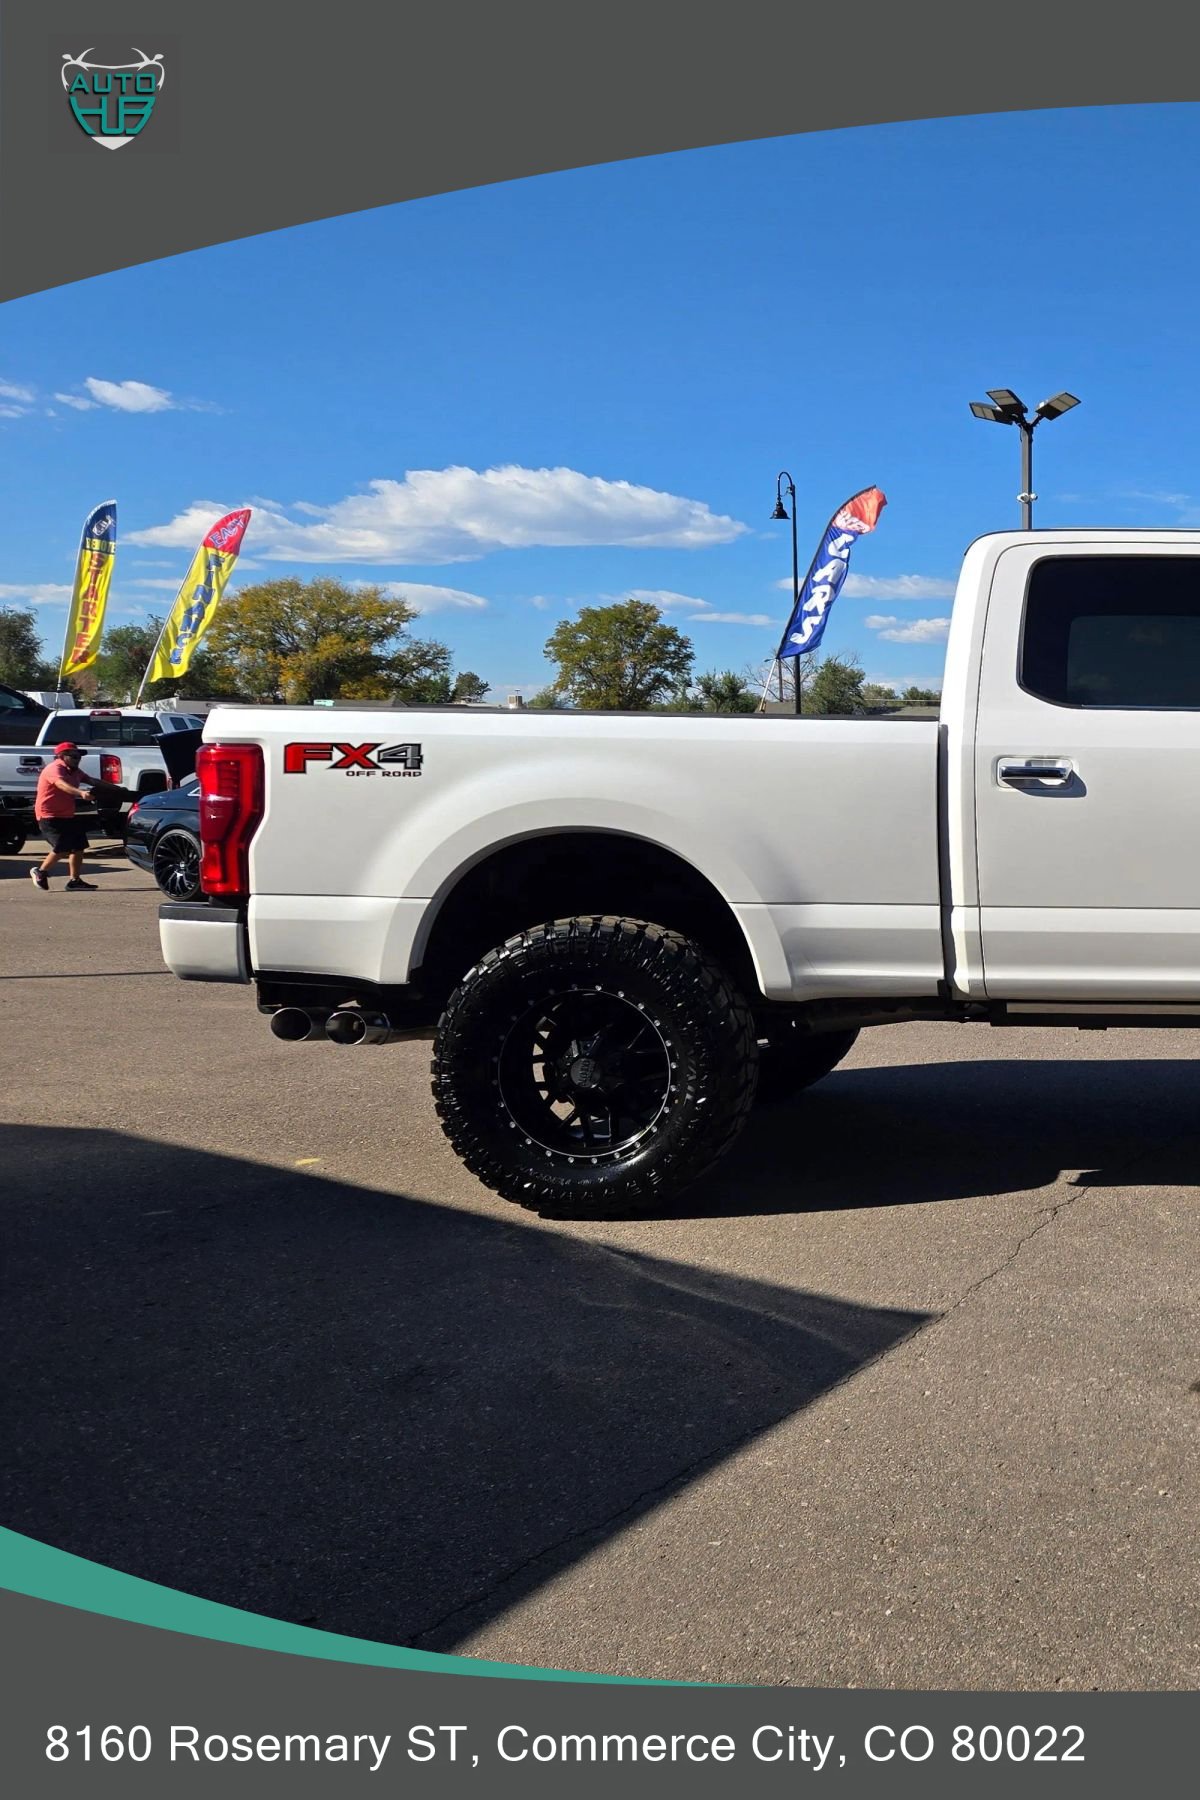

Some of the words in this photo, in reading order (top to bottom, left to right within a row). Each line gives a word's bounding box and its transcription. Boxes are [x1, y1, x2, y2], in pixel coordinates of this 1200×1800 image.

[71, 551, 104, 664] STARTER
[790, 533, 854, 644] CARS
[284, 742, 424, 774] FX4
